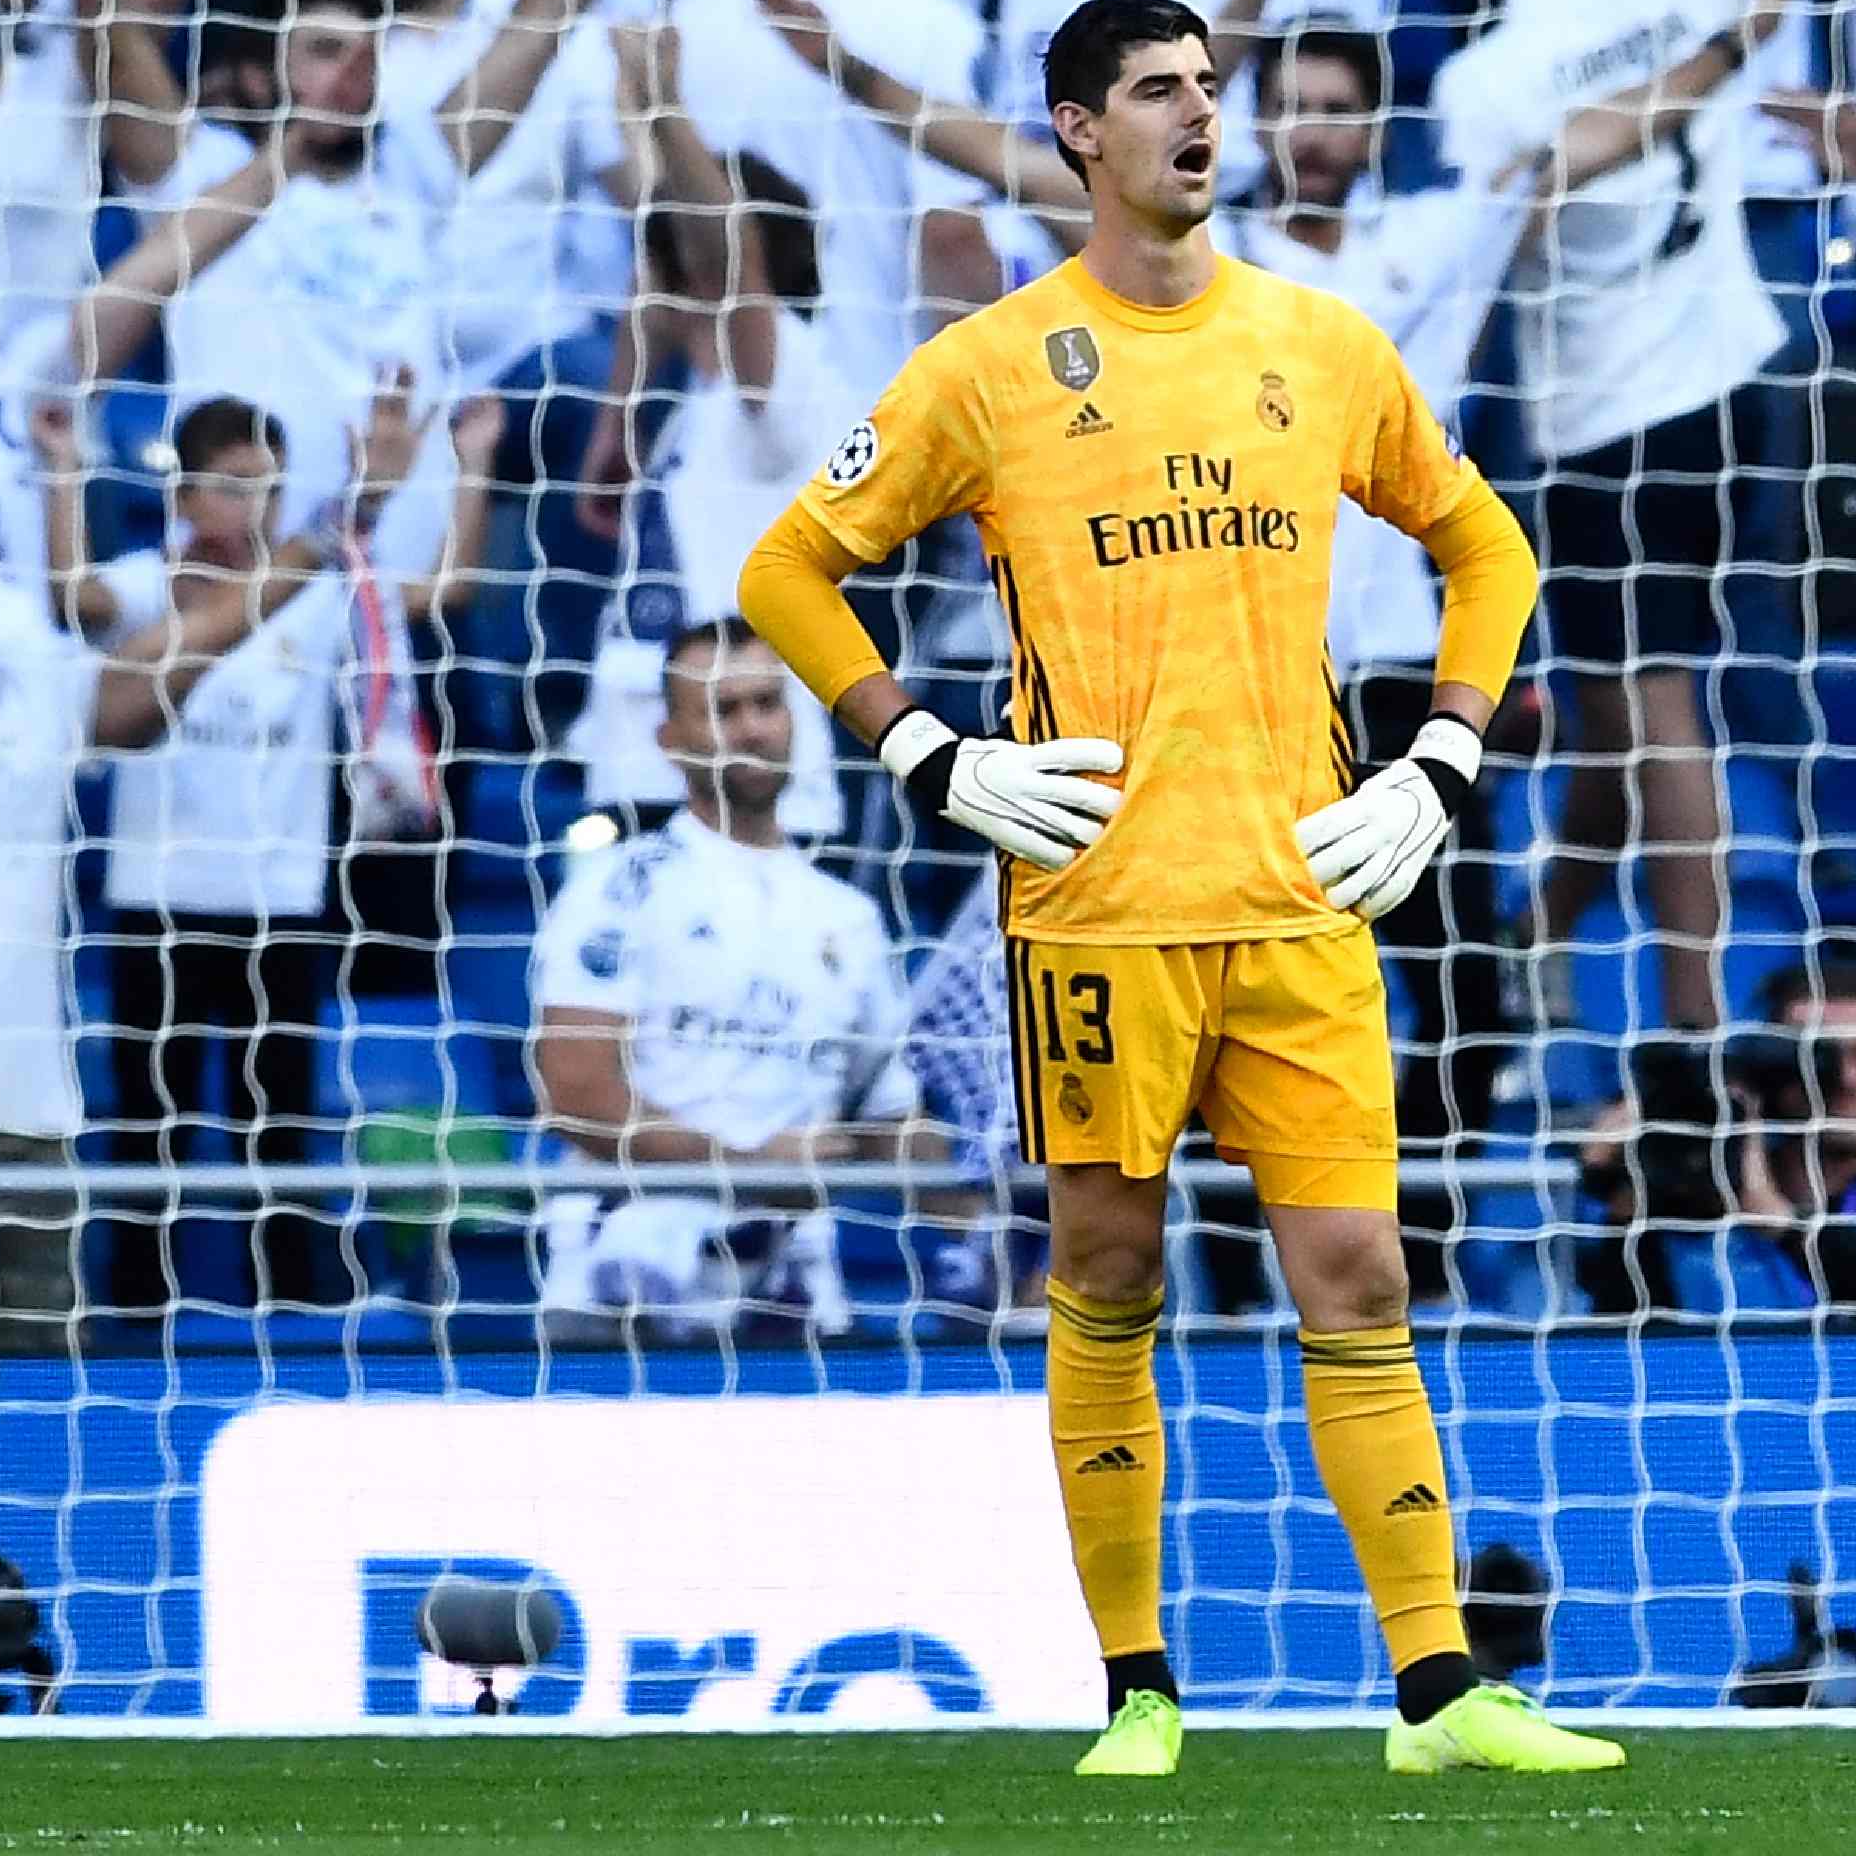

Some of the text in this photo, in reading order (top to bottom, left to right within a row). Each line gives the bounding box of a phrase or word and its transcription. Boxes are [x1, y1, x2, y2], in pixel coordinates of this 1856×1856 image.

[1065, 420, 1114, 440] adidas
[1164, 452, 1232, 495] Fly
[1087, 496, 1299, 568] Emirates
[1040, 969, 1115, 1064] 13
